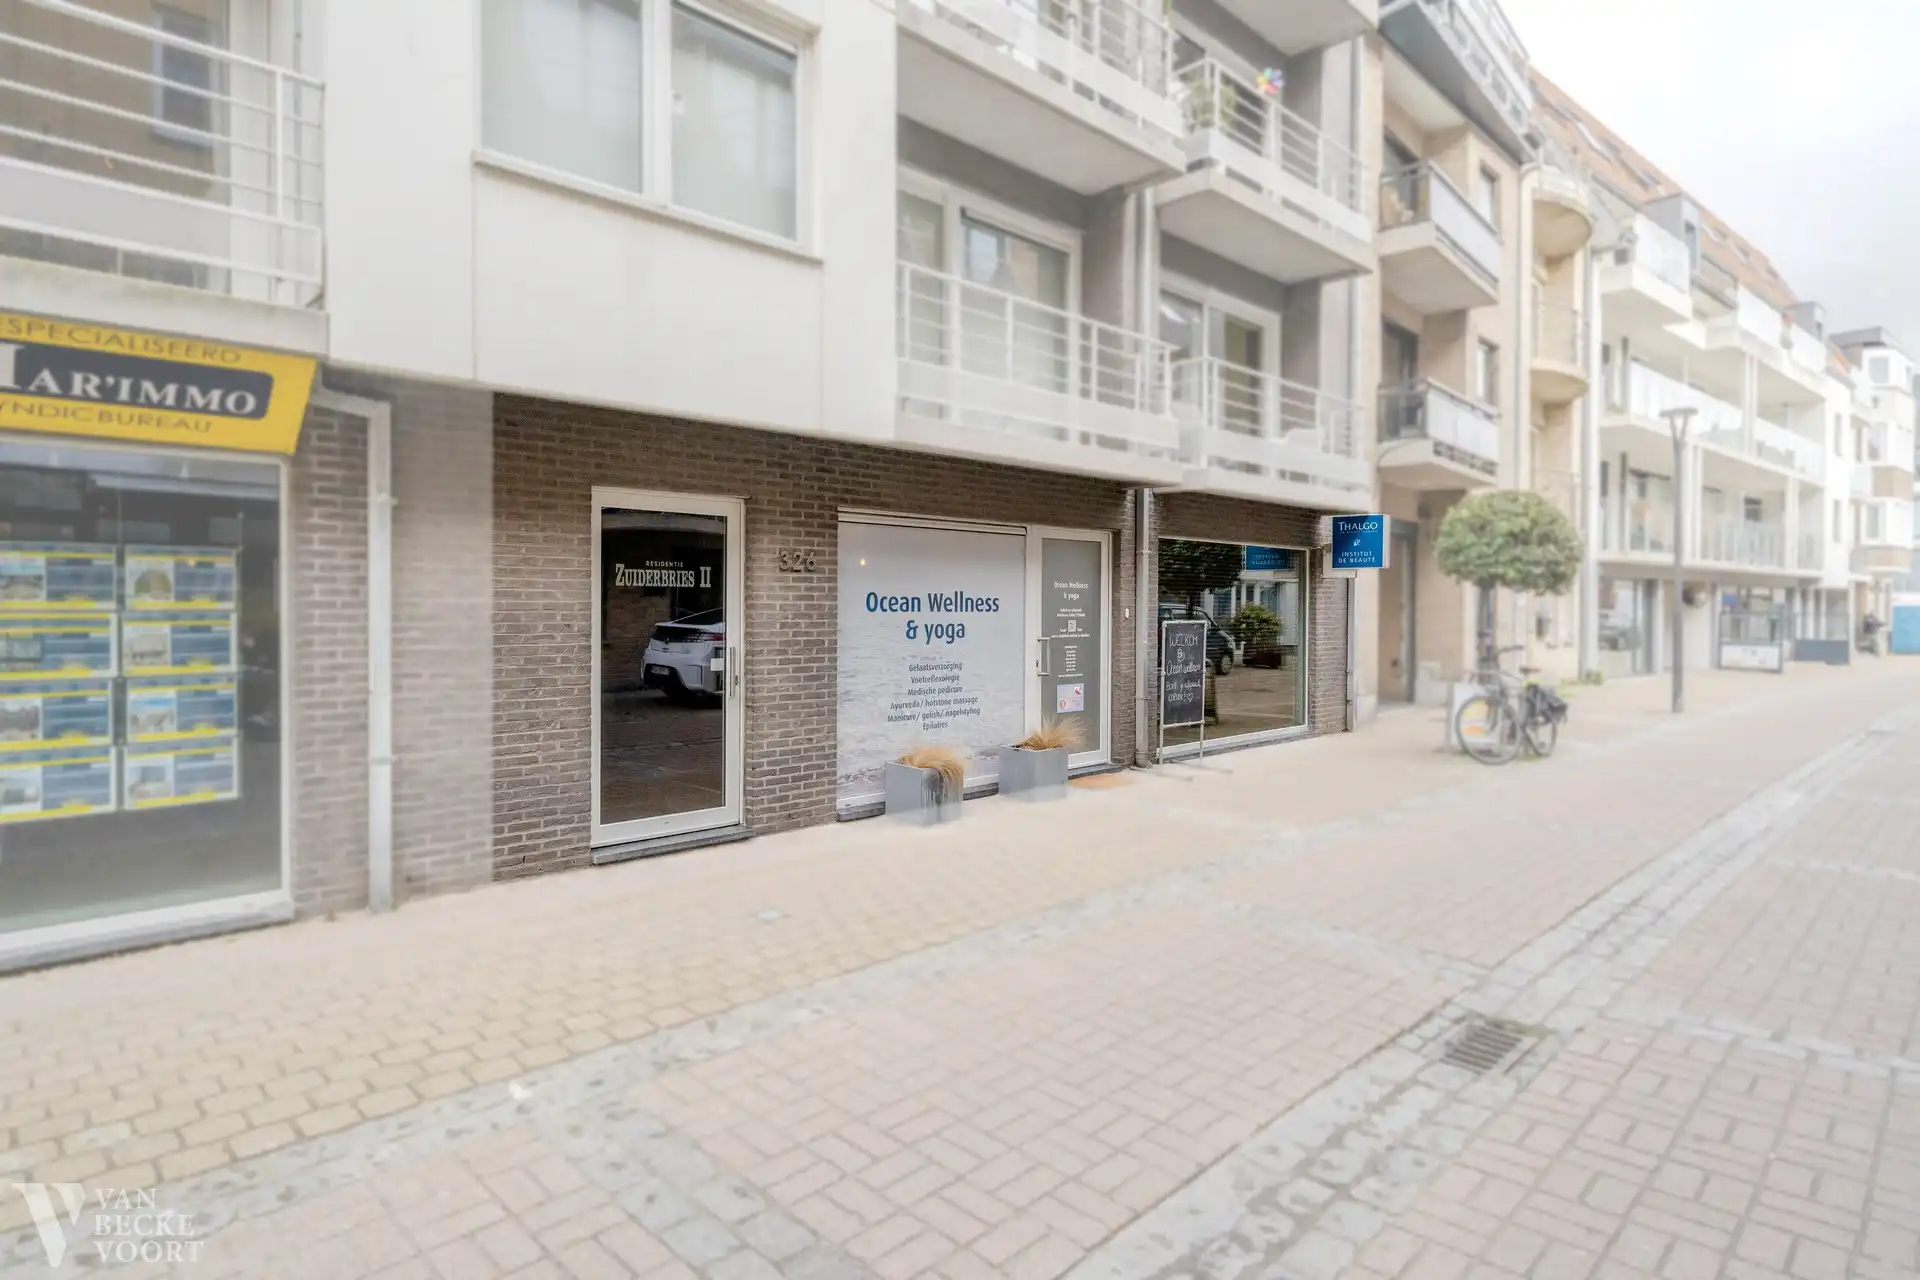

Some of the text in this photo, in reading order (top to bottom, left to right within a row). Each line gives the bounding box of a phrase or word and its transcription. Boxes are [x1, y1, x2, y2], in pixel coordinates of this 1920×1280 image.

[0, 316, 242, 364] SPECIALISEERD
[1338, 521, 1378, 531] THALGO
[645, 560, 684, 568] RESIDENTIE
[780, 550, 817, 570] 326
[615, 563, 712, 588] ZUIDERBRIES II
[866, 590, 1000, 613] Ocean Wellness
[905, 619, 966, 645] & yoga
[908, 661, 963, 672] Gelaatsverzorging
[911, 673, 961, 684] Voetreflexologie
[908, 685, 963, 696] Medische pedicure
[925, 698, 952, 707] hotstone
[953, 696, 979, 706] massage
[945, 707, 981, 718] nagelstyling
